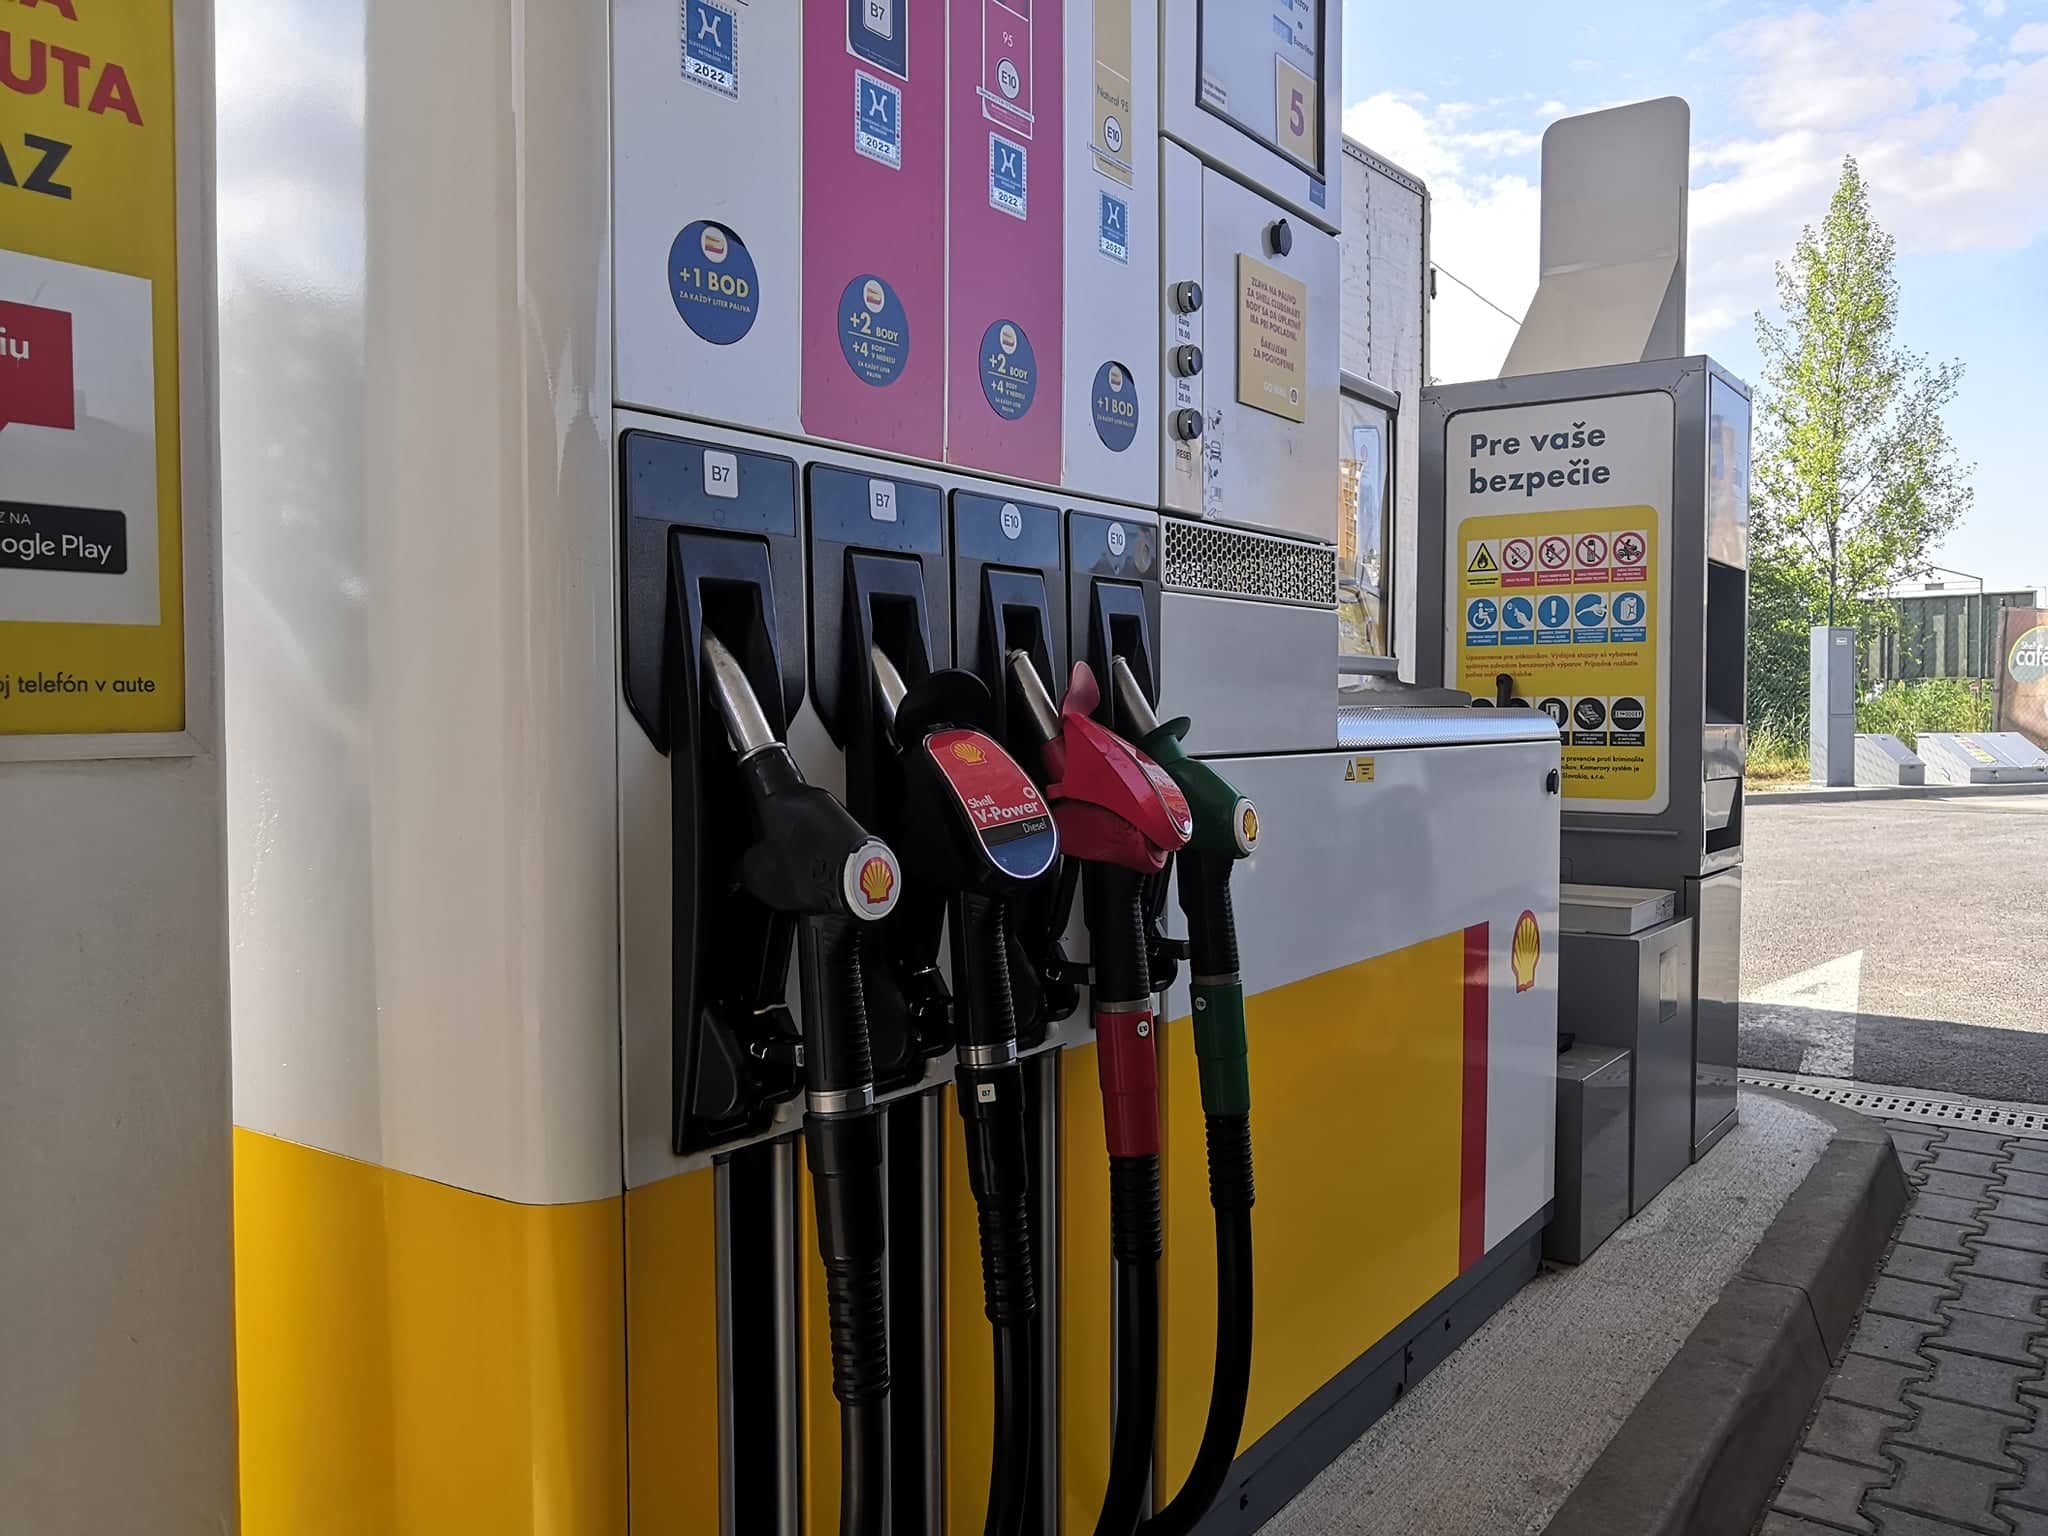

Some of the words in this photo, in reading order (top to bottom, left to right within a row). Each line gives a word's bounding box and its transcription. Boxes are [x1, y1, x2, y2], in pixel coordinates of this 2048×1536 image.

[870, 2, 885, 20] B7
[1002, 31, 1014, 48] 95
[694, 63, 725, 83] 2022
[1001, 70, 1017, 89] E10
[1290, 88, 1304, 137] 5
[1107, 126, 1120, 143] E10
[866, 136, 890, 154] 2022
[999, 191, 1018, 207] 2022
[1105, 240, 1122, 255] 2022
[679, 267, 701, 288] +1
[708, 271, 749, 298] BOD
[679, 290, 689, 299] ZA
[712, 298, 728, 309] LITER
[728, 301, 751, 313] PALIVA
[1247, 288, 1254, 298] ZA
[1256, 291, 1270, 306] SHELL
[1278, 289, 1296, 305] PALIVO
[1246, 299, 1261, 313] BODY
[1262, 306, 1269, 317] SA
[850, 311, 871, 335] +2
[876, 327, 899, 342] BODY
[1178, 315, 1190, 328] Euro
[852, 341, 869, 357] +4
[1253, 347, 1260, 358] ZA
[989, 353, 1006, 374] +2
[1009, 366, 1028, 380] BODY
[991, 379, 1004, 394] +4
[1178, 379, 1190, 392] Euro
[1097, 396, 1109, 412] +1
[1111, 398, 1134, 417] BOD
[1470, 432, 1520, 459] Pre
[1530, 420, 1606, 452] vaše
[711, 465, 730, 483] B7
[1469, 458, 1611, 496] bezpečie
[875, 493, 890, 508] B7
[10, 512, 31, 525] NA
[1003, 513, 1019, 529] E10
[1110, 532, 1124, 546] E10
[62, 535, 112, 565] Play
[18, 672, 88, 693] telefón
[95, 680, 107, 692] v
[112, 676, 156, 693] aute
[967, 794, 995, 809] Shell
[974, 801, 1038, 823] V-Power
[1022, 817, 1047, 833] Diesel
